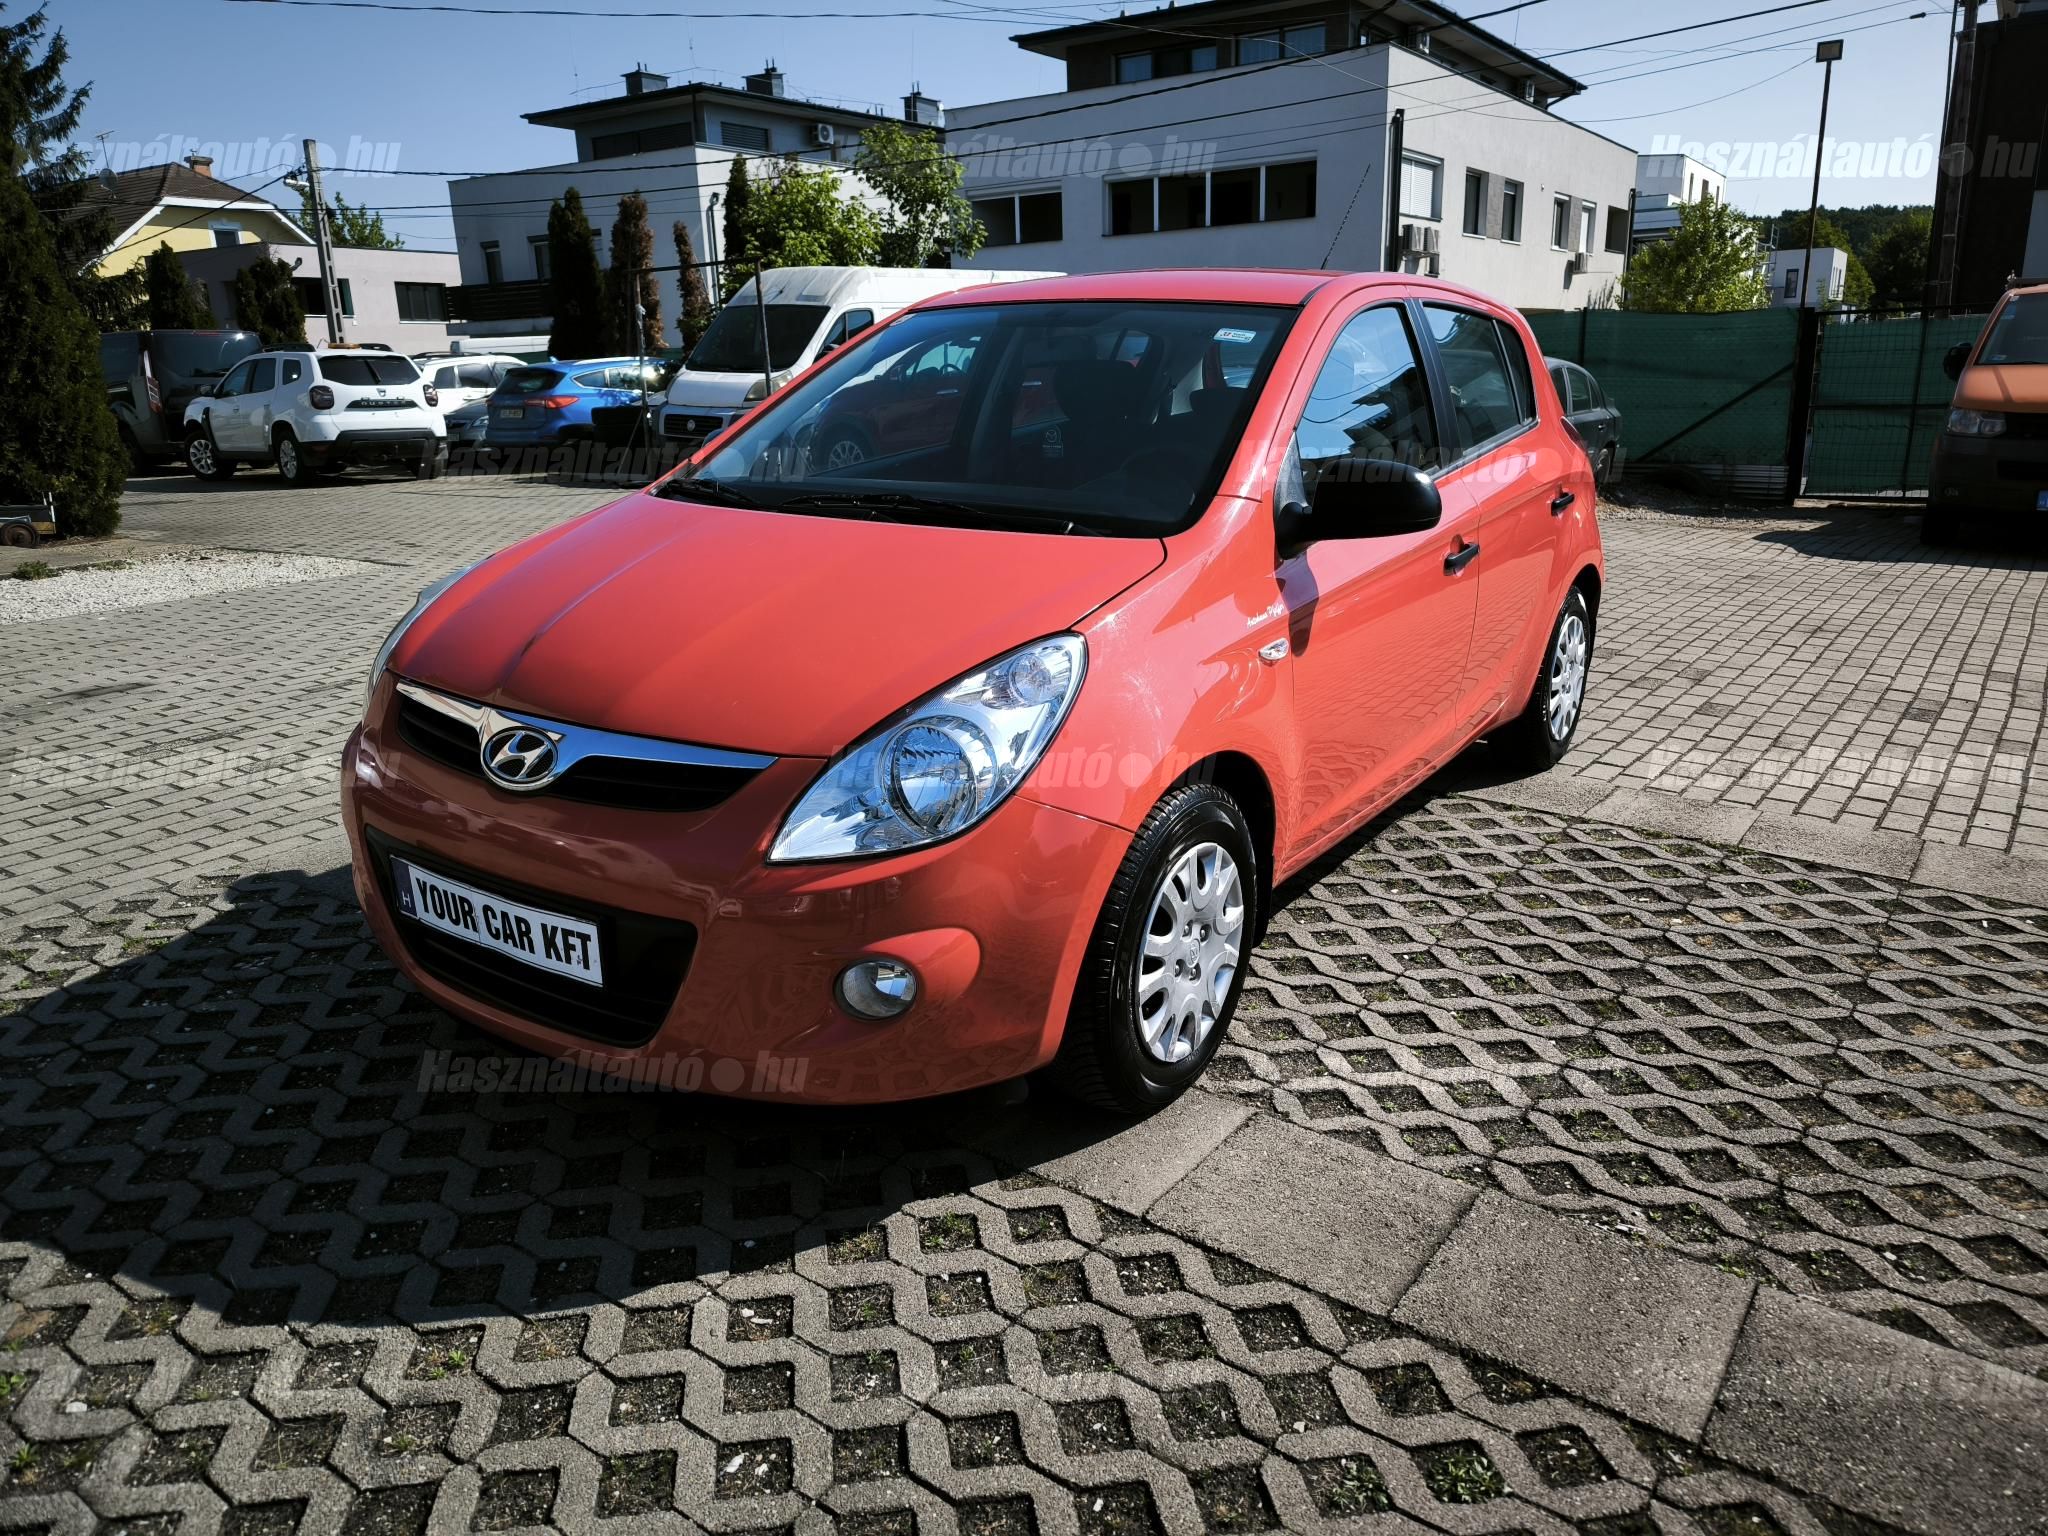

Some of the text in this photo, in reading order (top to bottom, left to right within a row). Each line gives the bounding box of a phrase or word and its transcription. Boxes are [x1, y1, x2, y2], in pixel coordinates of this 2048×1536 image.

[415, 877, 592, 971] YOUR CAR KFT
